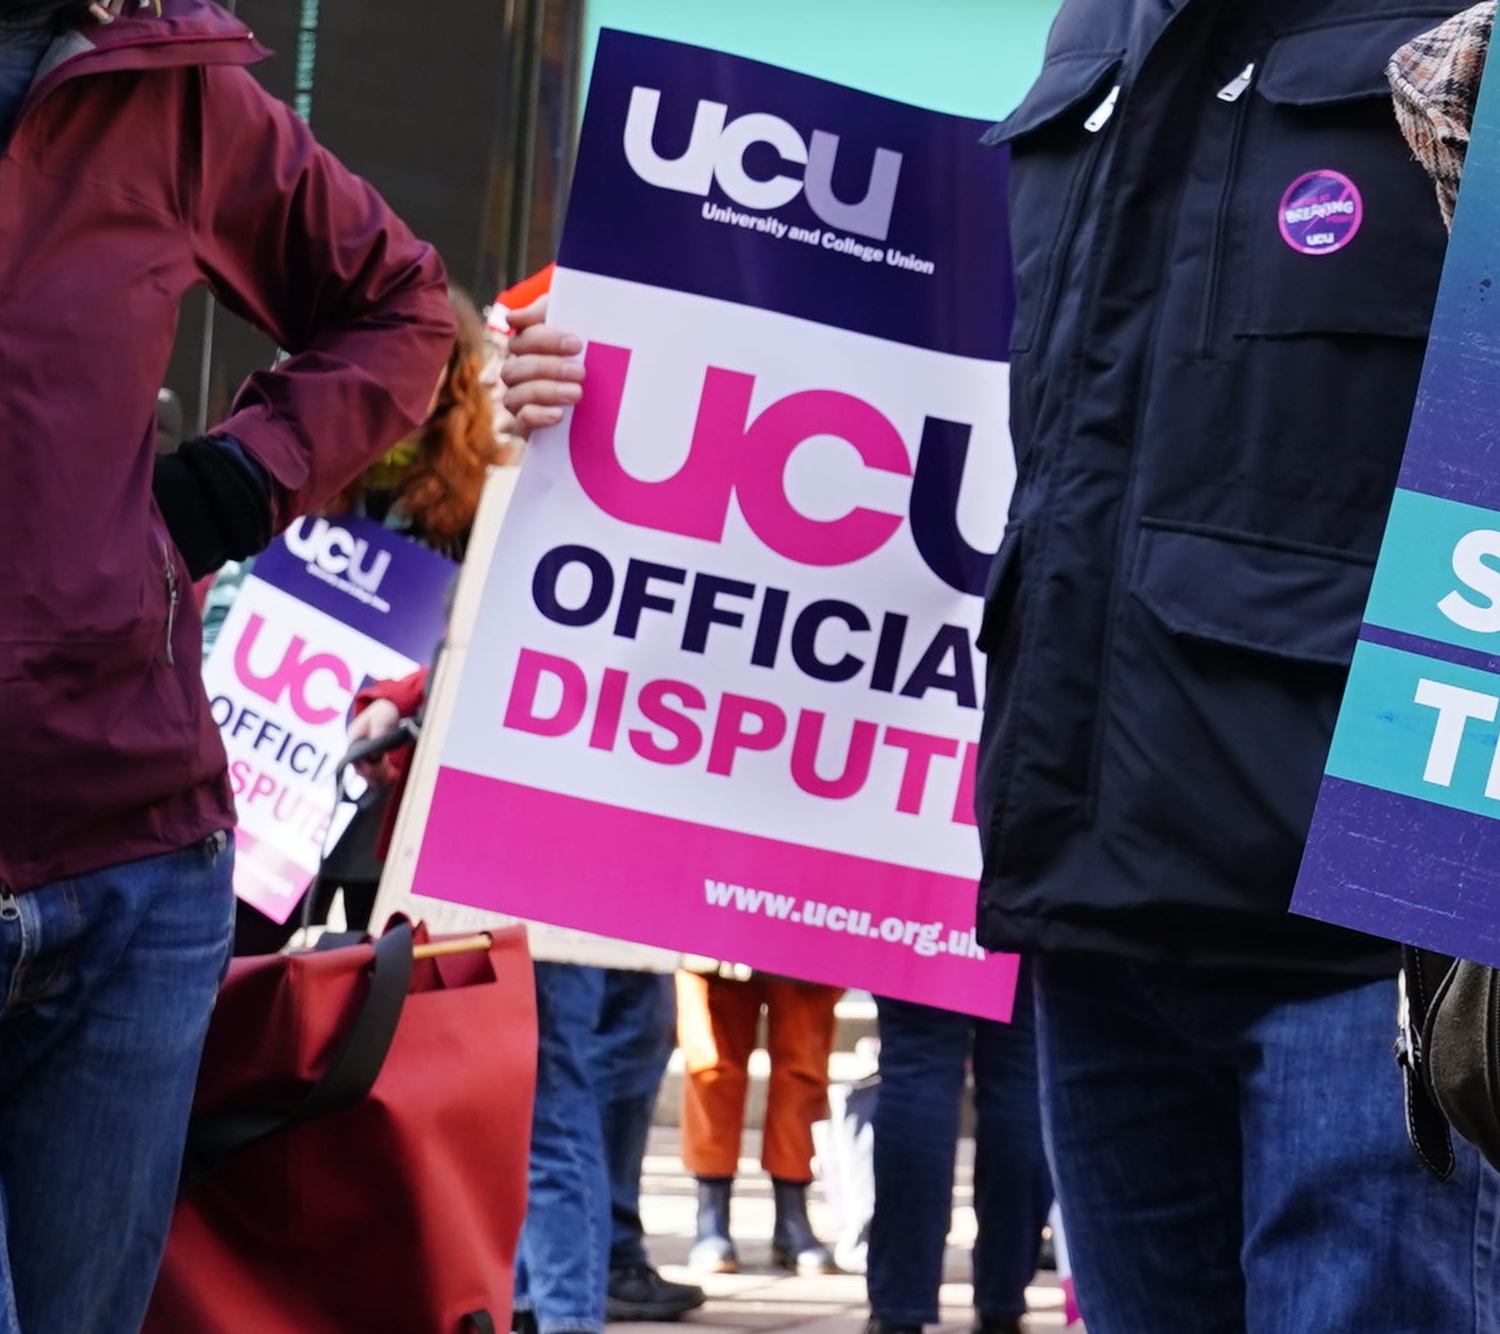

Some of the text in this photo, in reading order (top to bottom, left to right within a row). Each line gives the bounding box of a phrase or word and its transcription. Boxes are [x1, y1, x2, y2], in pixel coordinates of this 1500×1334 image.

[624, 85, 903, 241] UCU
[700, 201, 935, 275] University and College Union
[284, 515, 392, 593] UCU
[530, 544, 984, 711] OFFICIA
[209, 694, 329, 783] OFFICI
